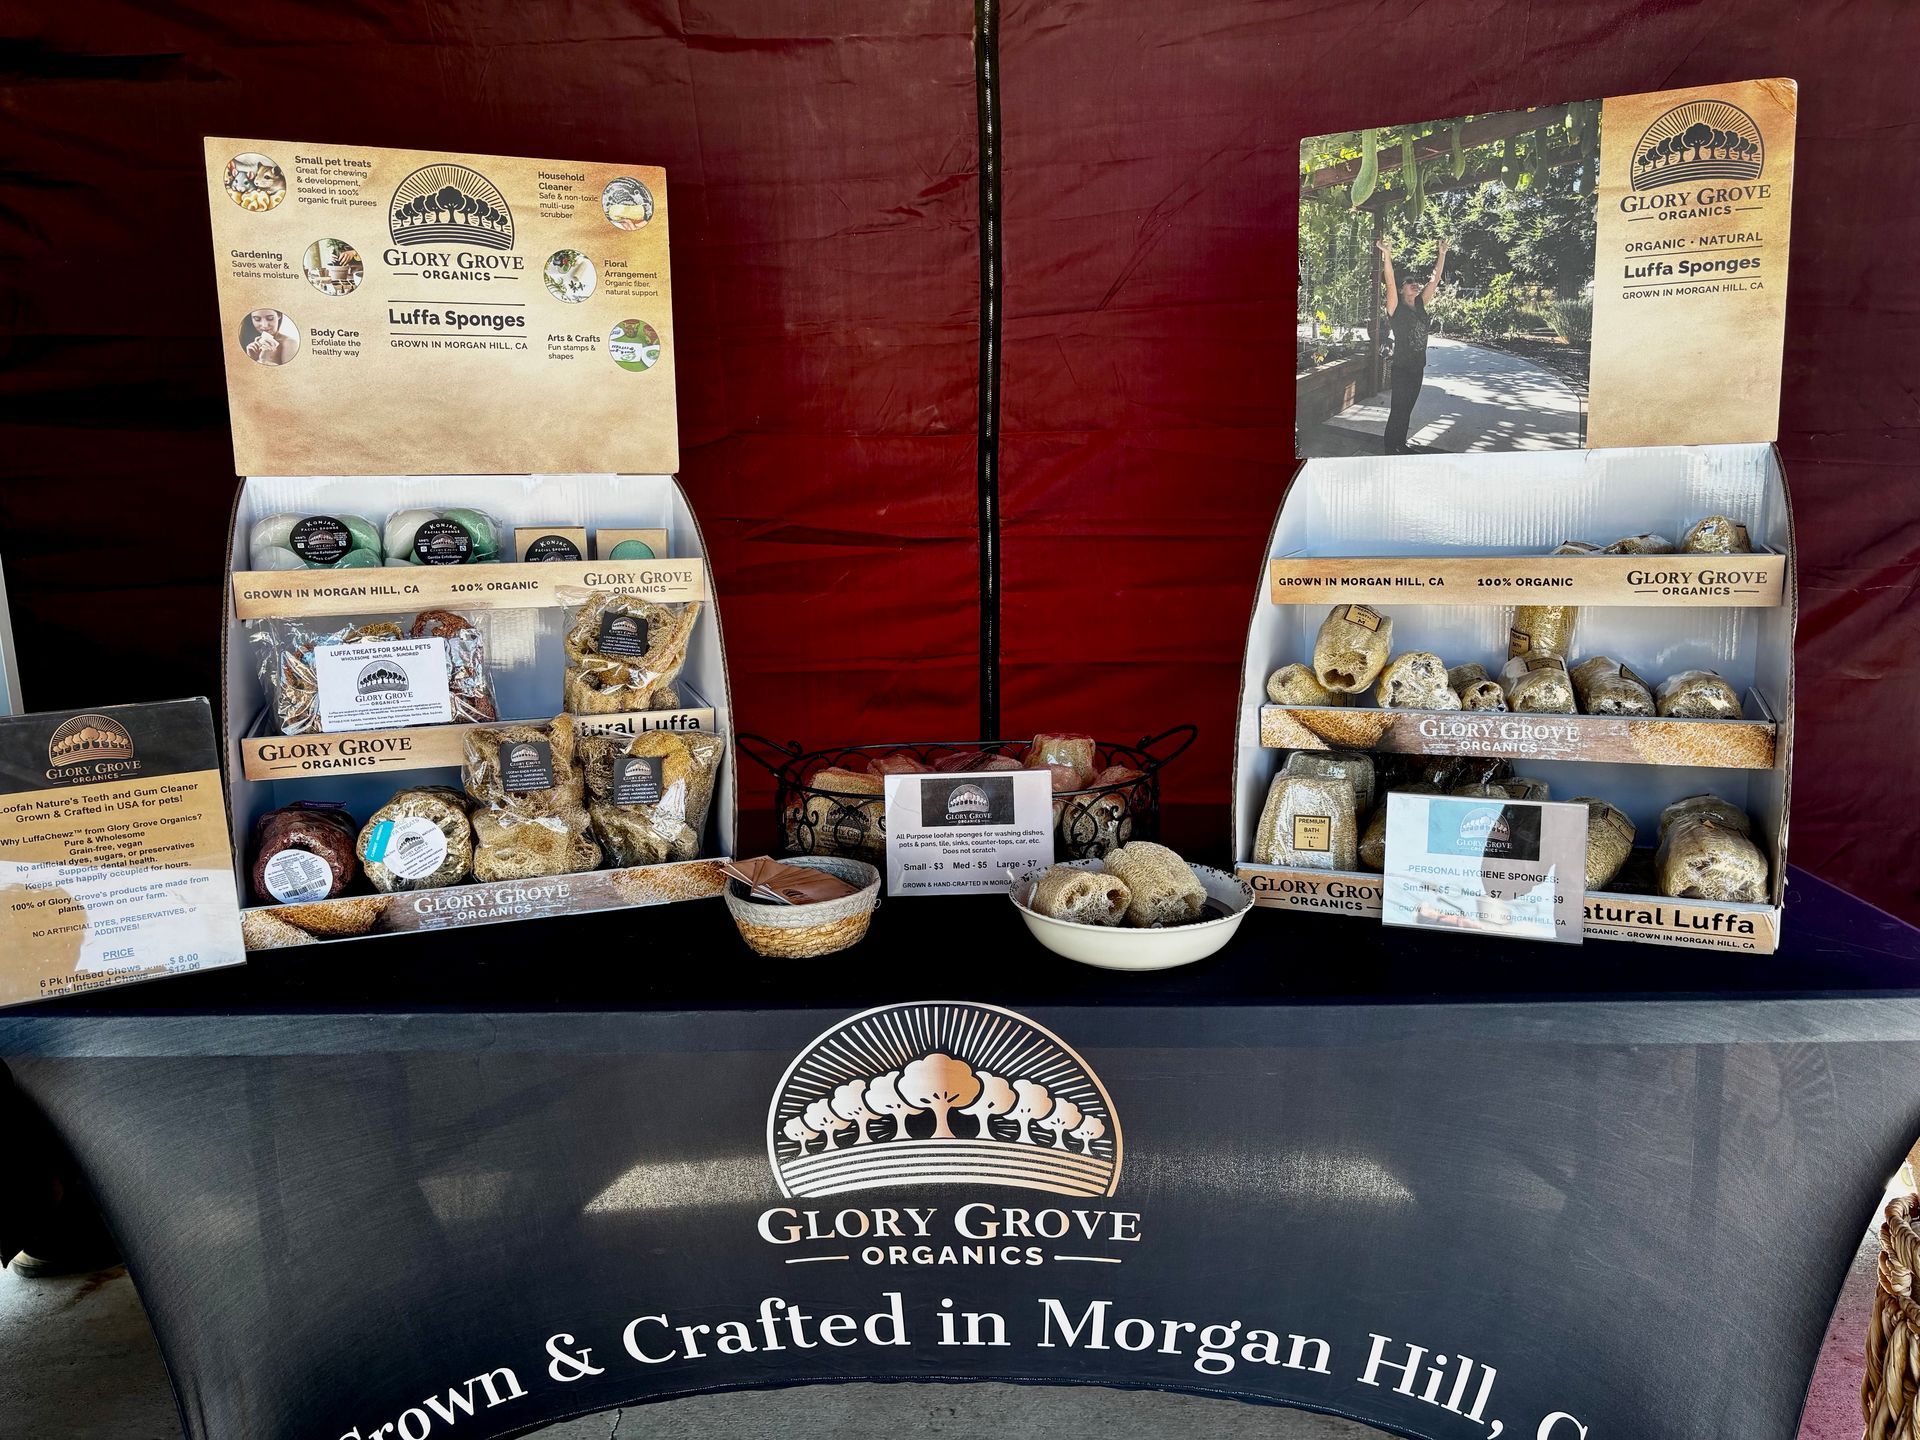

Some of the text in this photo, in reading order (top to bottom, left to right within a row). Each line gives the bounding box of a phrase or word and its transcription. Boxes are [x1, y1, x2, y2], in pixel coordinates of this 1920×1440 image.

[295, 156, 371, 167] Small pet treats
[538, 172, 585, 181] Household
[539, 183, 572, 191] Cleaner
[1620, 185, 1771, 212] GLORY GROVE
[1659, 206, 1731, 220] ORGANICS
[1625, 232, 1763, 252] ORGANIC NATURAL
[231, 250, 282, 261] Gardening
[383, 249, 524, 270] GLORY GROVE
[605, 270, 657, 279] Arrangement
[1625, 258, 1760, 278] Luffa Sponges
[423, 270, 490, 281] ORGANICS
[1623, 290, 1659, 299] GROWN
[1676, 285, 1719, 295] MORGAN
[1723, 283, 1747, 292] HILL,
[1750, 282, 1764, 290] CA
[389, 309, 525, 330] Luffa Sponges
[311, 329, 359, 338] Body Care
[391, 340, 428, 348] GROWN
[490, 342, 512, 350] HILL,
[312, 349, 342, 357] healthy
[584, 572, 692, 586] GLORY GROVE
[1279, 577, 1444, 587] GROWN IN MORGAN HILL, CA
[1477, 578, 1573, 586] 100% ORGANIC
[1627, 570, 1767, 585] GLORY GROVE
[244, 585, 419, 599] GROWN IN MORGAN HILL, CA
[451, 581, 538, 592] 100% ORGANIC
[1662, 587, 1730, 595] ORGANICS
[643, 715, 700, 732] Luffa
[1419, 720, 1579, 741] GLORY GROVE
[258, 737, 412, 761] GLORY GROVE
[1461, 741, 1538, 752] ORGANICS
[302, 757, 375, 769] ORGANICS
[36, 798, 79, 809] Nature's
[82, 794, 109, 803] Teeth
[113, 791, 130, 799] and
[134, 788, 157, 796] Gum
[161, 783, 198, 793] Cleaner
[16, 813, 50, 823] Grown
[64, 805, 101, 817] Crafted
[117, 801, 139, 810] USA
[142, 799, 156, 807] for
[159, 795, 183, 807] pets!
[0, 838, 19, 848] Why
[85, 827, 105, 835] from
[107, 824, 130, 833] Glory
[133, 819, 158, 828] Grove
[161, 813, 202, 825] Organics?
[907, 833, 932, 841] Purpose
[956, 832, 983, 840] sponges
[995, 830, 1021, 838] washing
[971, 838, 1014, 846] counter-tops,
[904, 860, 1037, 871] Small $3 Med $5 Large $7
[1408, 865, 1559, 884] PERSONAL HYGIENE SPONGES:
[1251, 876, 1320, 894] GLORY
[414, 883, 570, 914] GLORY GROVE
[1290, 896, 1362, 910] ORGANICS
[458, 904, 532, 920] ORGANICS
[1583, 904, 1754, 933] atural Luffa
[1627, 932, 1660, 940] GROWN
[1675, 936, 1714, 945] MORGAN
[1717, 940, 1740, 948] HILL,
[103, 948, 134, 959] PRICE
[757, 1202, 1142, 1244] GLORY GROVE
[861, 1245, 1043, 1265] ORGANICS
[545, 1333, 605, 1382] &
[622, 1292, 911, 1364] Crafted
[936, 1298, 1011, 1346] in
[1037, 1298, 1331, 1375] Morgan
[1357, 1333, 1504, 1439] Hill,
